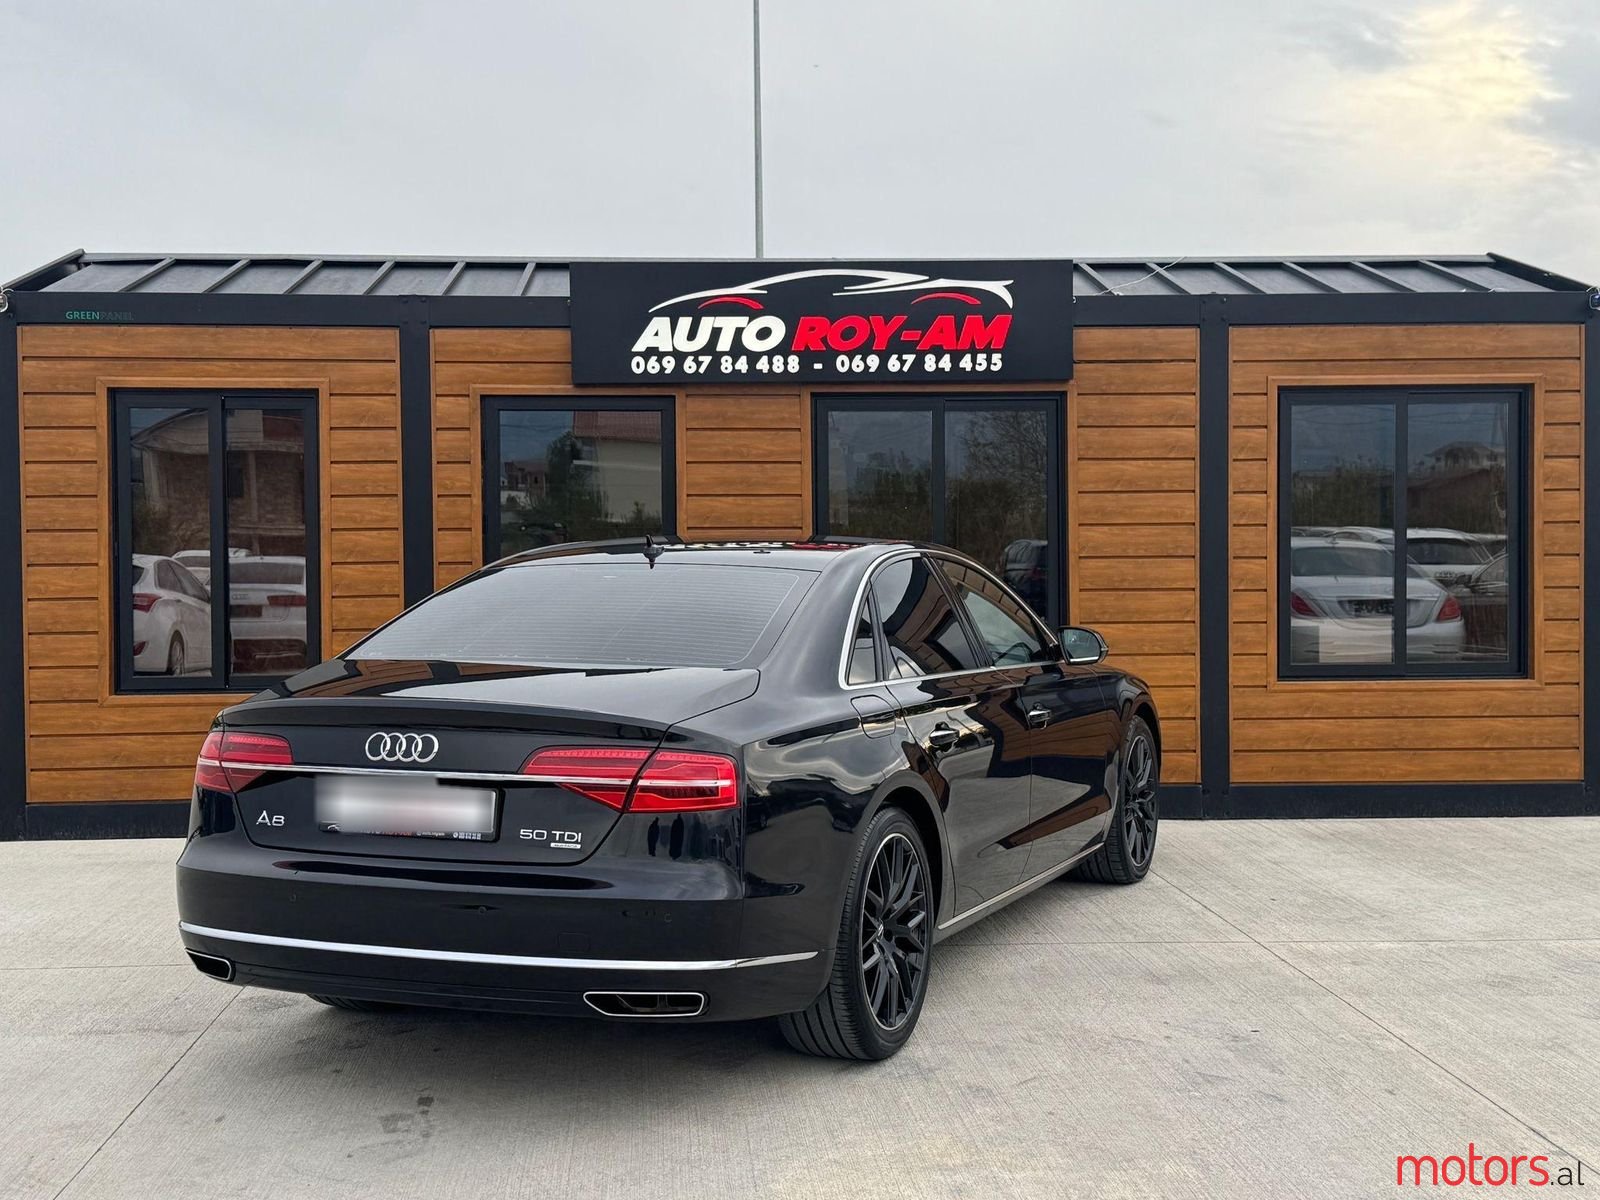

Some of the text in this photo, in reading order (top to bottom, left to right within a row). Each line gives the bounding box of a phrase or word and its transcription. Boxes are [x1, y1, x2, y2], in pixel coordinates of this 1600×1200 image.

[631, 315, 1012, 352] AUTO ROY-AM
[631, 355, 676, 374] 069
[683, 355, 713, 374] 67
[720, 355, 749, 374] 84
[755, 355, 800, 374] 488
[835, 354, 880, 373] 069
[887, 354, 916, 373] 67
[924, 353, 952, 372] 84
[959, 353, 1003, 372] 455
[256, 810, 285, 827] A8
[519, 829, 582, 843] 50 TDI
